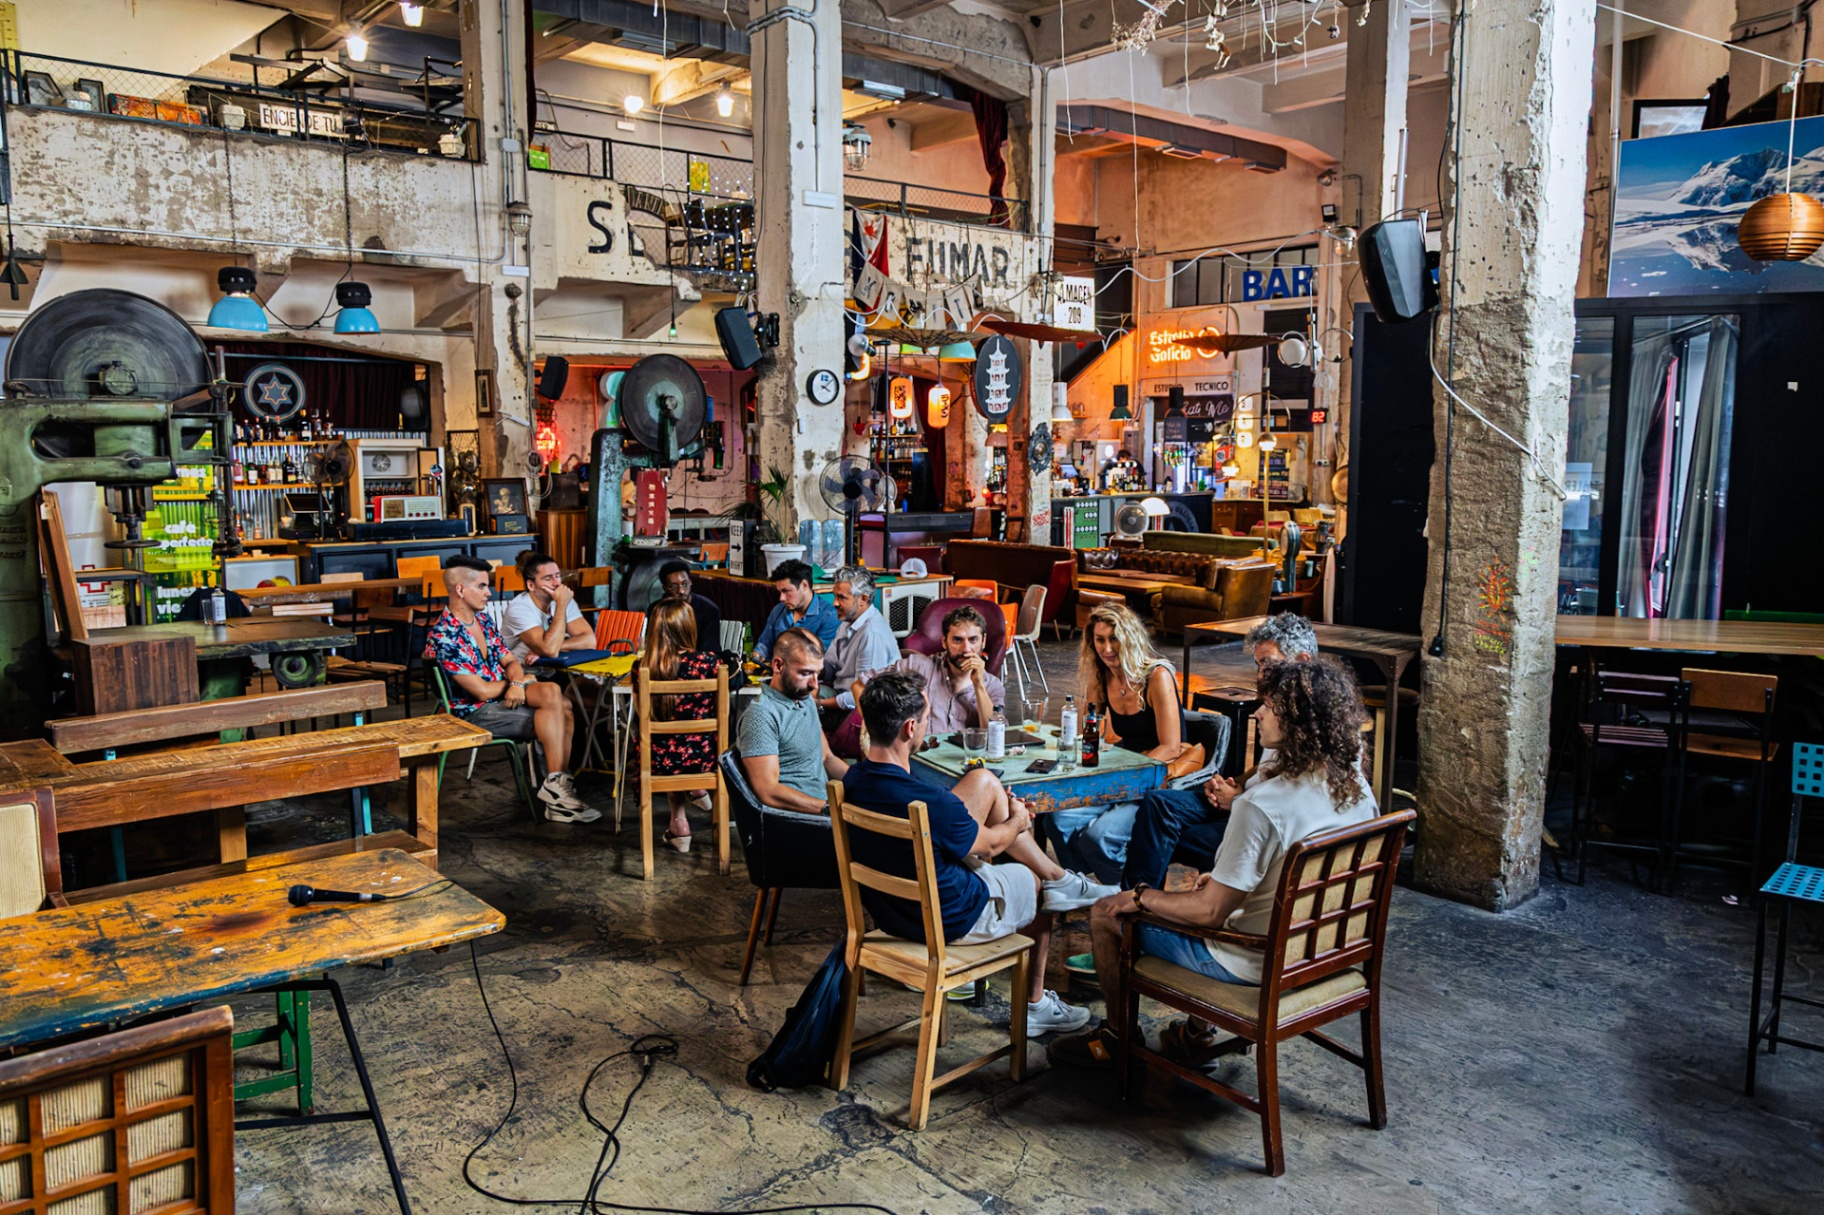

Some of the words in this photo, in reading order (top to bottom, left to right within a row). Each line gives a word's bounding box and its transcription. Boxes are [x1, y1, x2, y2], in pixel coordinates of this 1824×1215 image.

[906, 236, 1009, 288] FUMAR
[1242, 265, 1313, 302] BAR
[1068, 306, 1081, 324] 209
[1150, 345, 1192, 363] Galicia
[1154, 383, 1183, 393] ESTU
[1195, 381, 1229, 392] TECNICO
[1205, 400, 1230, 417] Me
[1311, 411, 1325, 423] 82
[730, 525, 743, 537] KEEP
[147, 535, 214, 551] perfecto
